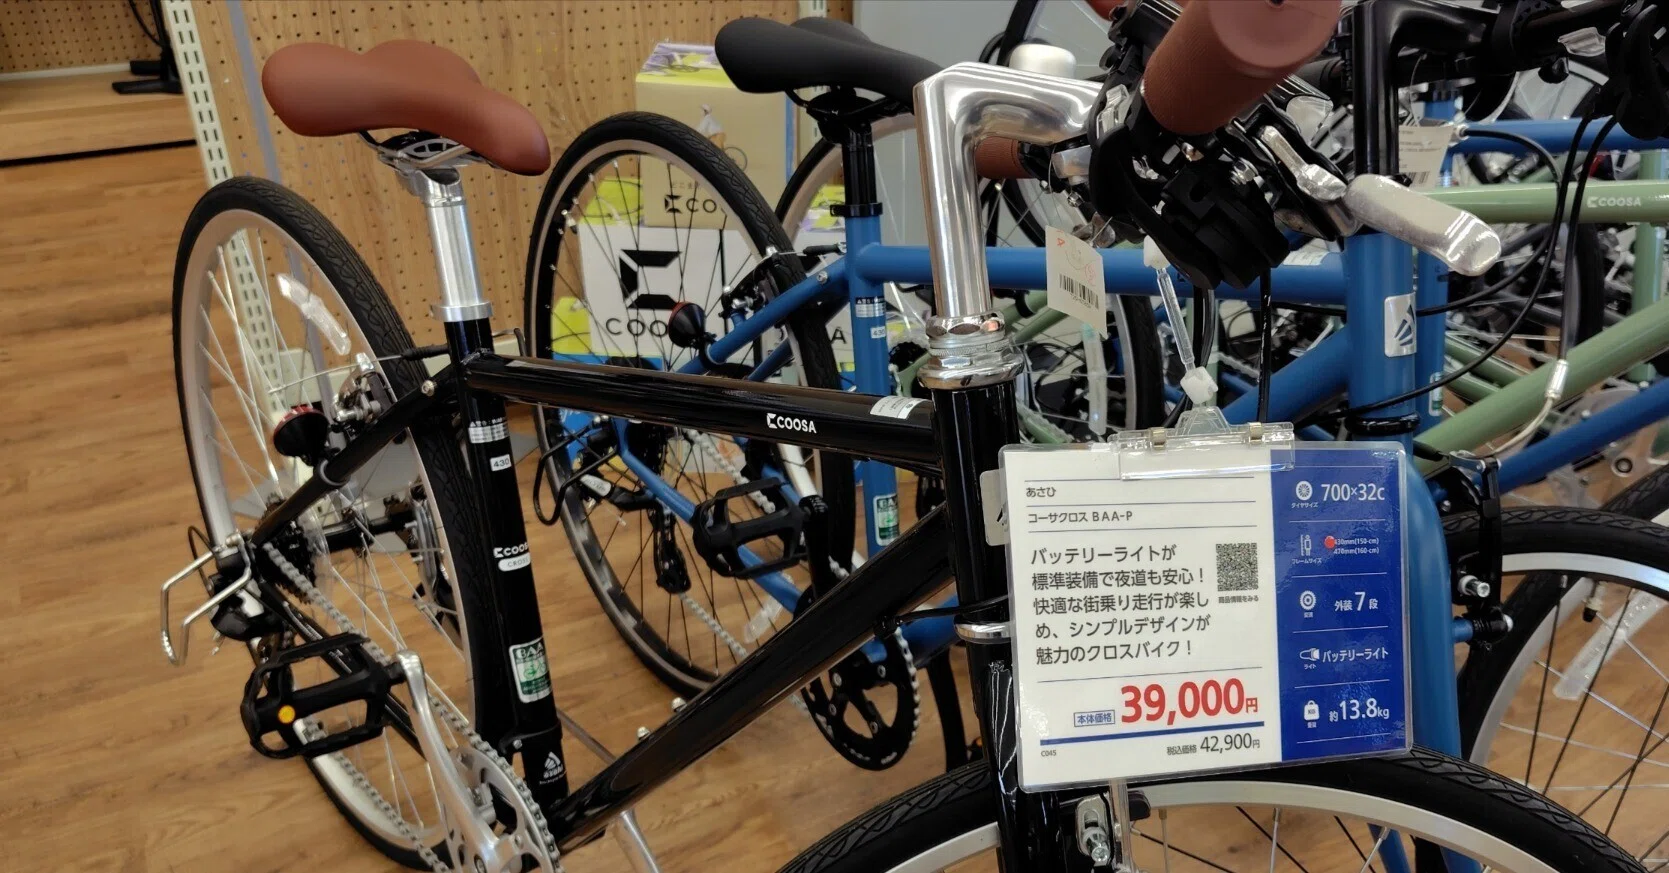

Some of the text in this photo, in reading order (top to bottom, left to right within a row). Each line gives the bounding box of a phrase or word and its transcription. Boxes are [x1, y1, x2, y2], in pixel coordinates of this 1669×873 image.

[1598, 197, 1641, 207] COOSA
[606, 318, 668, 337] COO
[776, 415, 817, 434] COOSA
[1026, 487, 1056, 498] あさひ
[1028, 511, 1133, 523] コーサクロス BAA-P
[503, 541, 529, 556] COOS
[1031, 544, 1177, 565] バッテリーライトが
[1033, 592, 1209, 615] 快適な街乗り走行が楽し
[1035, 614, 1211, 639] め、シンプルデザインが
[1322, 647, 1388, 662] バッテリーライト
[1077, 711, 1112, 724] 本体価格
[1167, 746, 1197, 755] 税込価格
